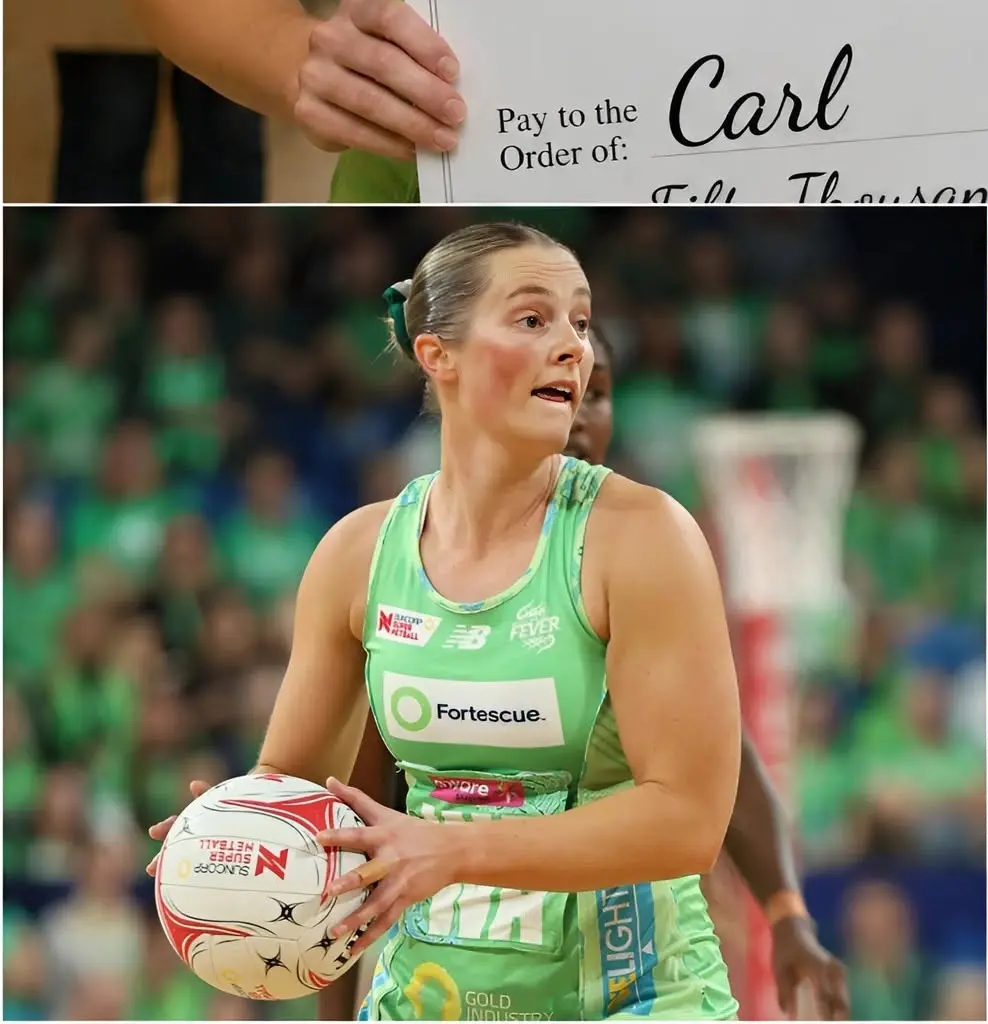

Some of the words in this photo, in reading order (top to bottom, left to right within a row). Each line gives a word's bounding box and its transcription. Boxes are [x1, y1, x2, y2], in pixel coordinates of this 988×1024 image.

[669, 43, 853, 147] Carl
[496, 107, 547, 137] Pay
[558, 106, 585, 128] to
[595, 99, 639, 125] the
[500, 141, 583, 171] Order
[592, 135, 628, 163] of:
[510, 616, 562, 642] FEVER
[200, 839, 254, 852] NETBALL
[209, 851, 252, 864] SUPER
[465, 990, 511, 1009] GOLD
